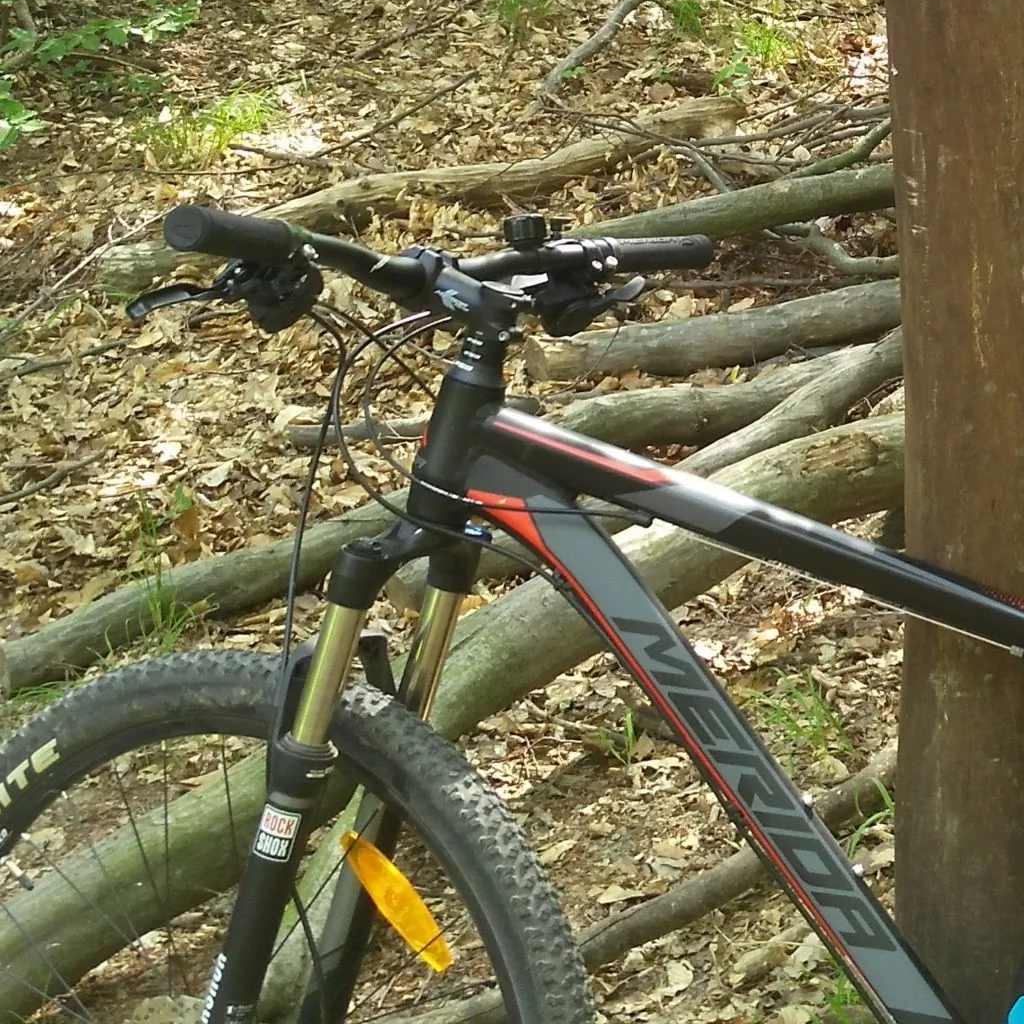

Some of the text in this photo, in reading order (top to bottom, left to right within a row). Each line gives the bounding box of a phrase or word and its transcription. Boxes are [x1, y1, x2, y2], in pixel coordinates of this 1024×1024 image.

[0, 738, 61, 808] ITE
[612, 616, 899, 952] MERIDA
[256, 832, 290, 857] SHOX
[264, 812, 295, 836] ROCK
